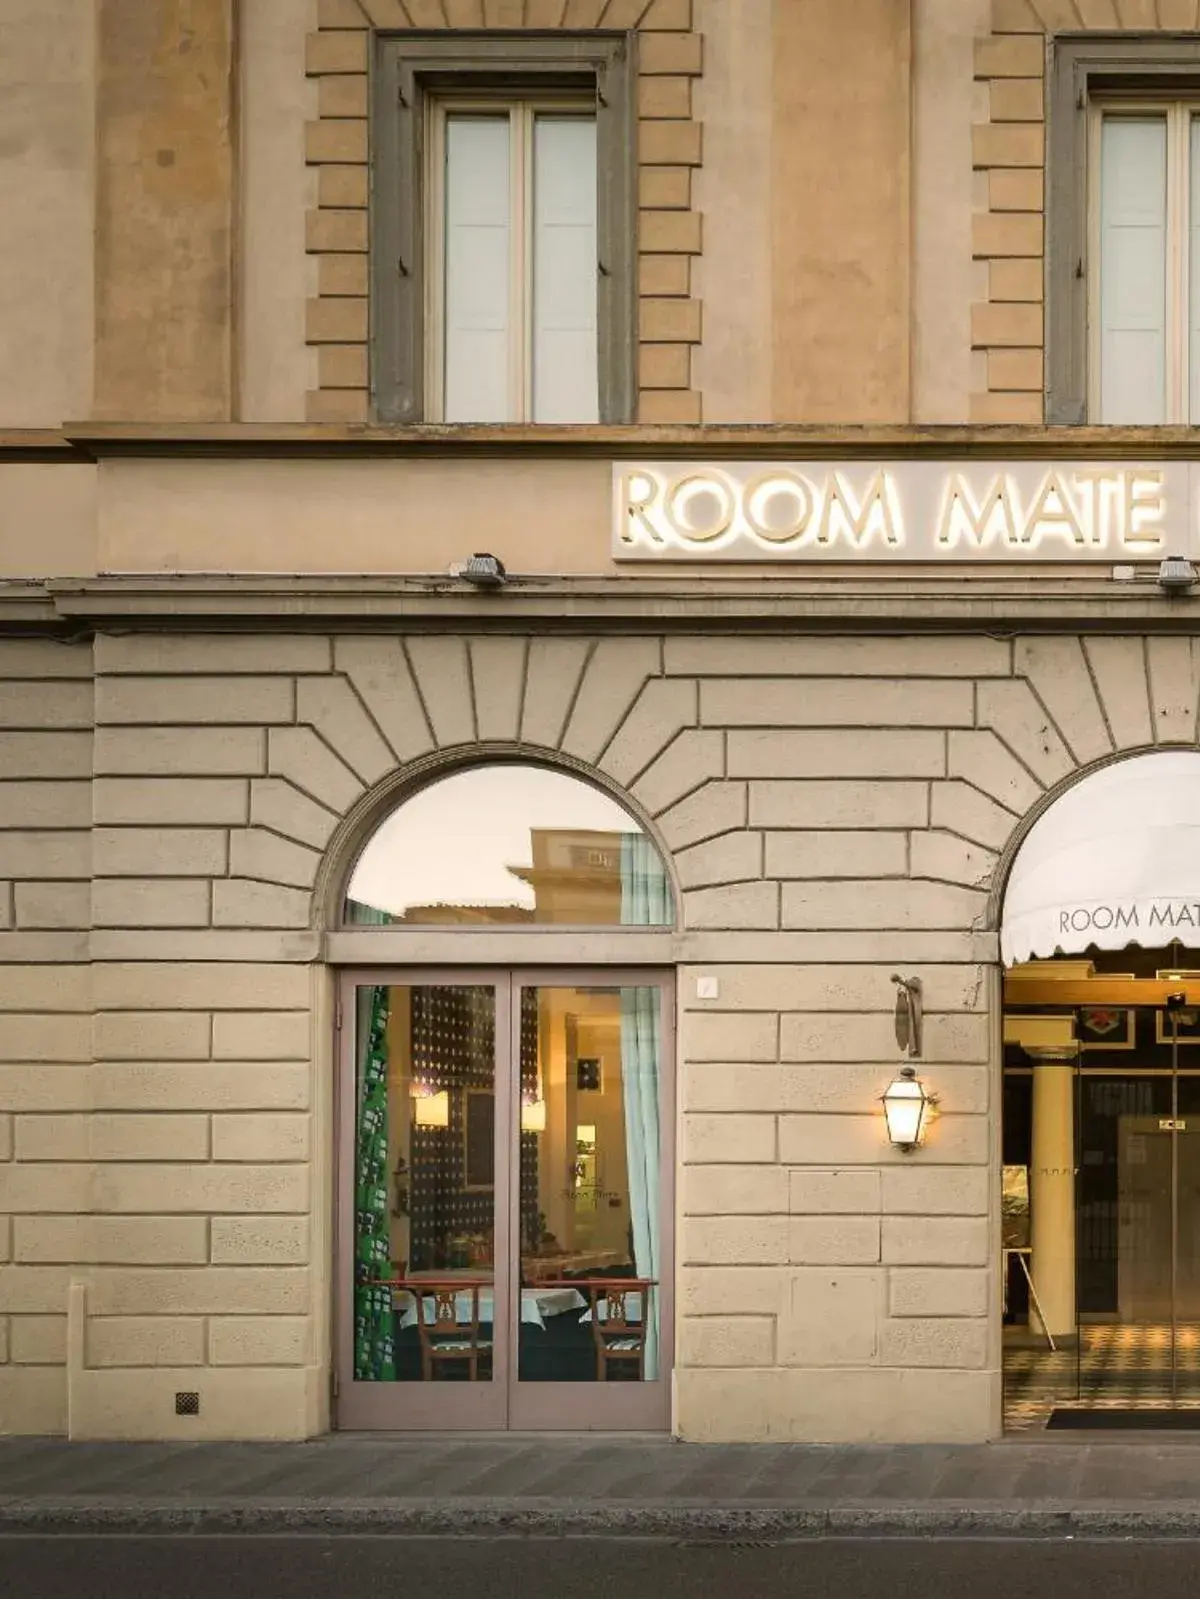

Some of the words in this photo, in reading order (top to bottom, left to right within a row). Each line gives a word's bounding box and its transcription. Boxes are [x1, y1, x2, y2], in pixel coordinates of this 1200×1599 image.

[618, 467, 900, 545] ROOM
[938, 467, 1165, 545] MATE
[1059, 903, 1140, 933] ROOM
